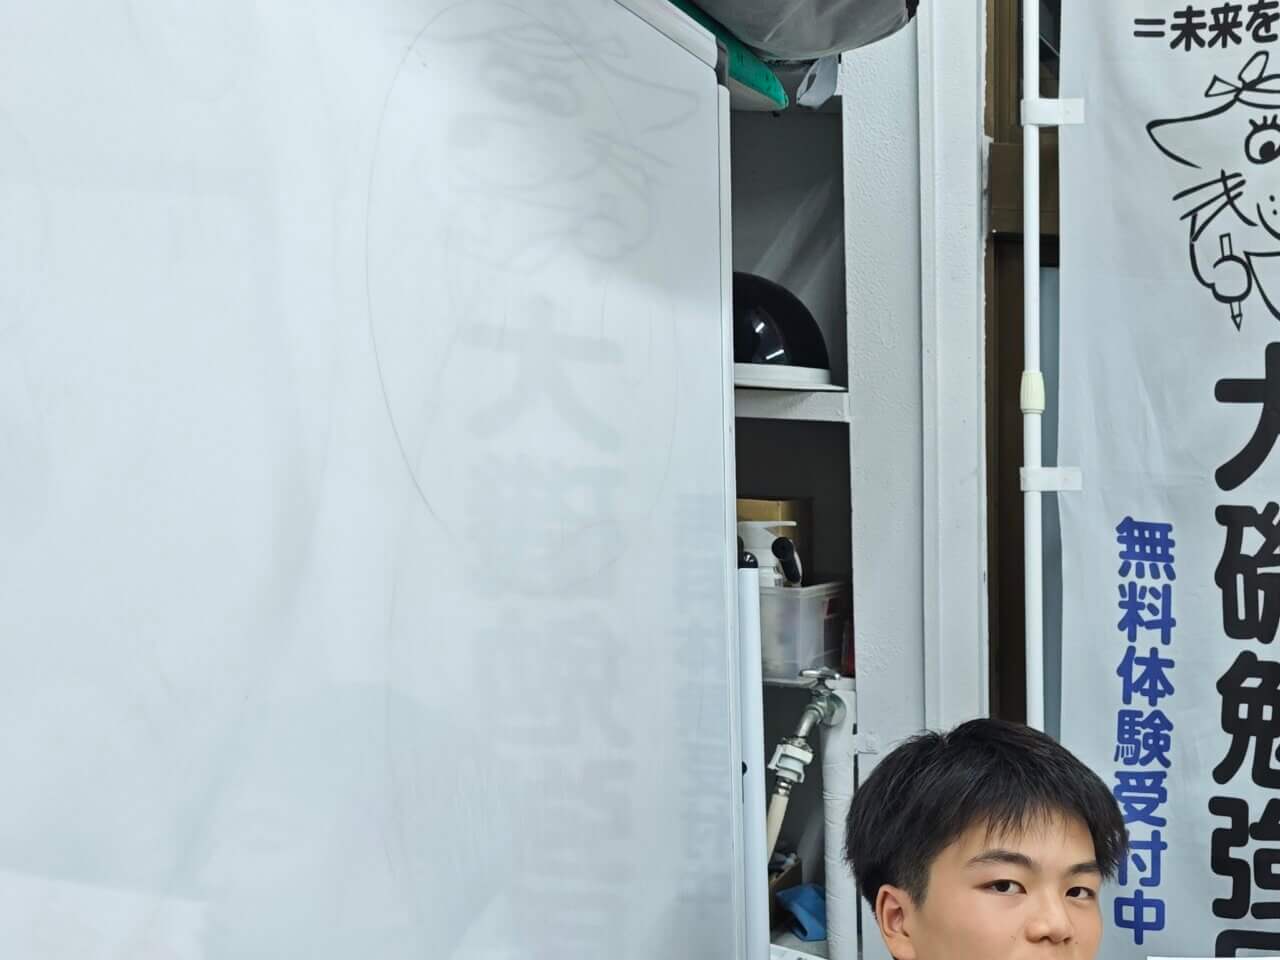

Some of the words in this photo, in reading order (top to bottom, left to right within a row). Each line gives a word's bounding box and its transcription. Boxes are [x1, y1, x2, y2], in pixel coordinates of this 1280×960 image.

[1113, 516, 1176, 946] 無料体験受付中
